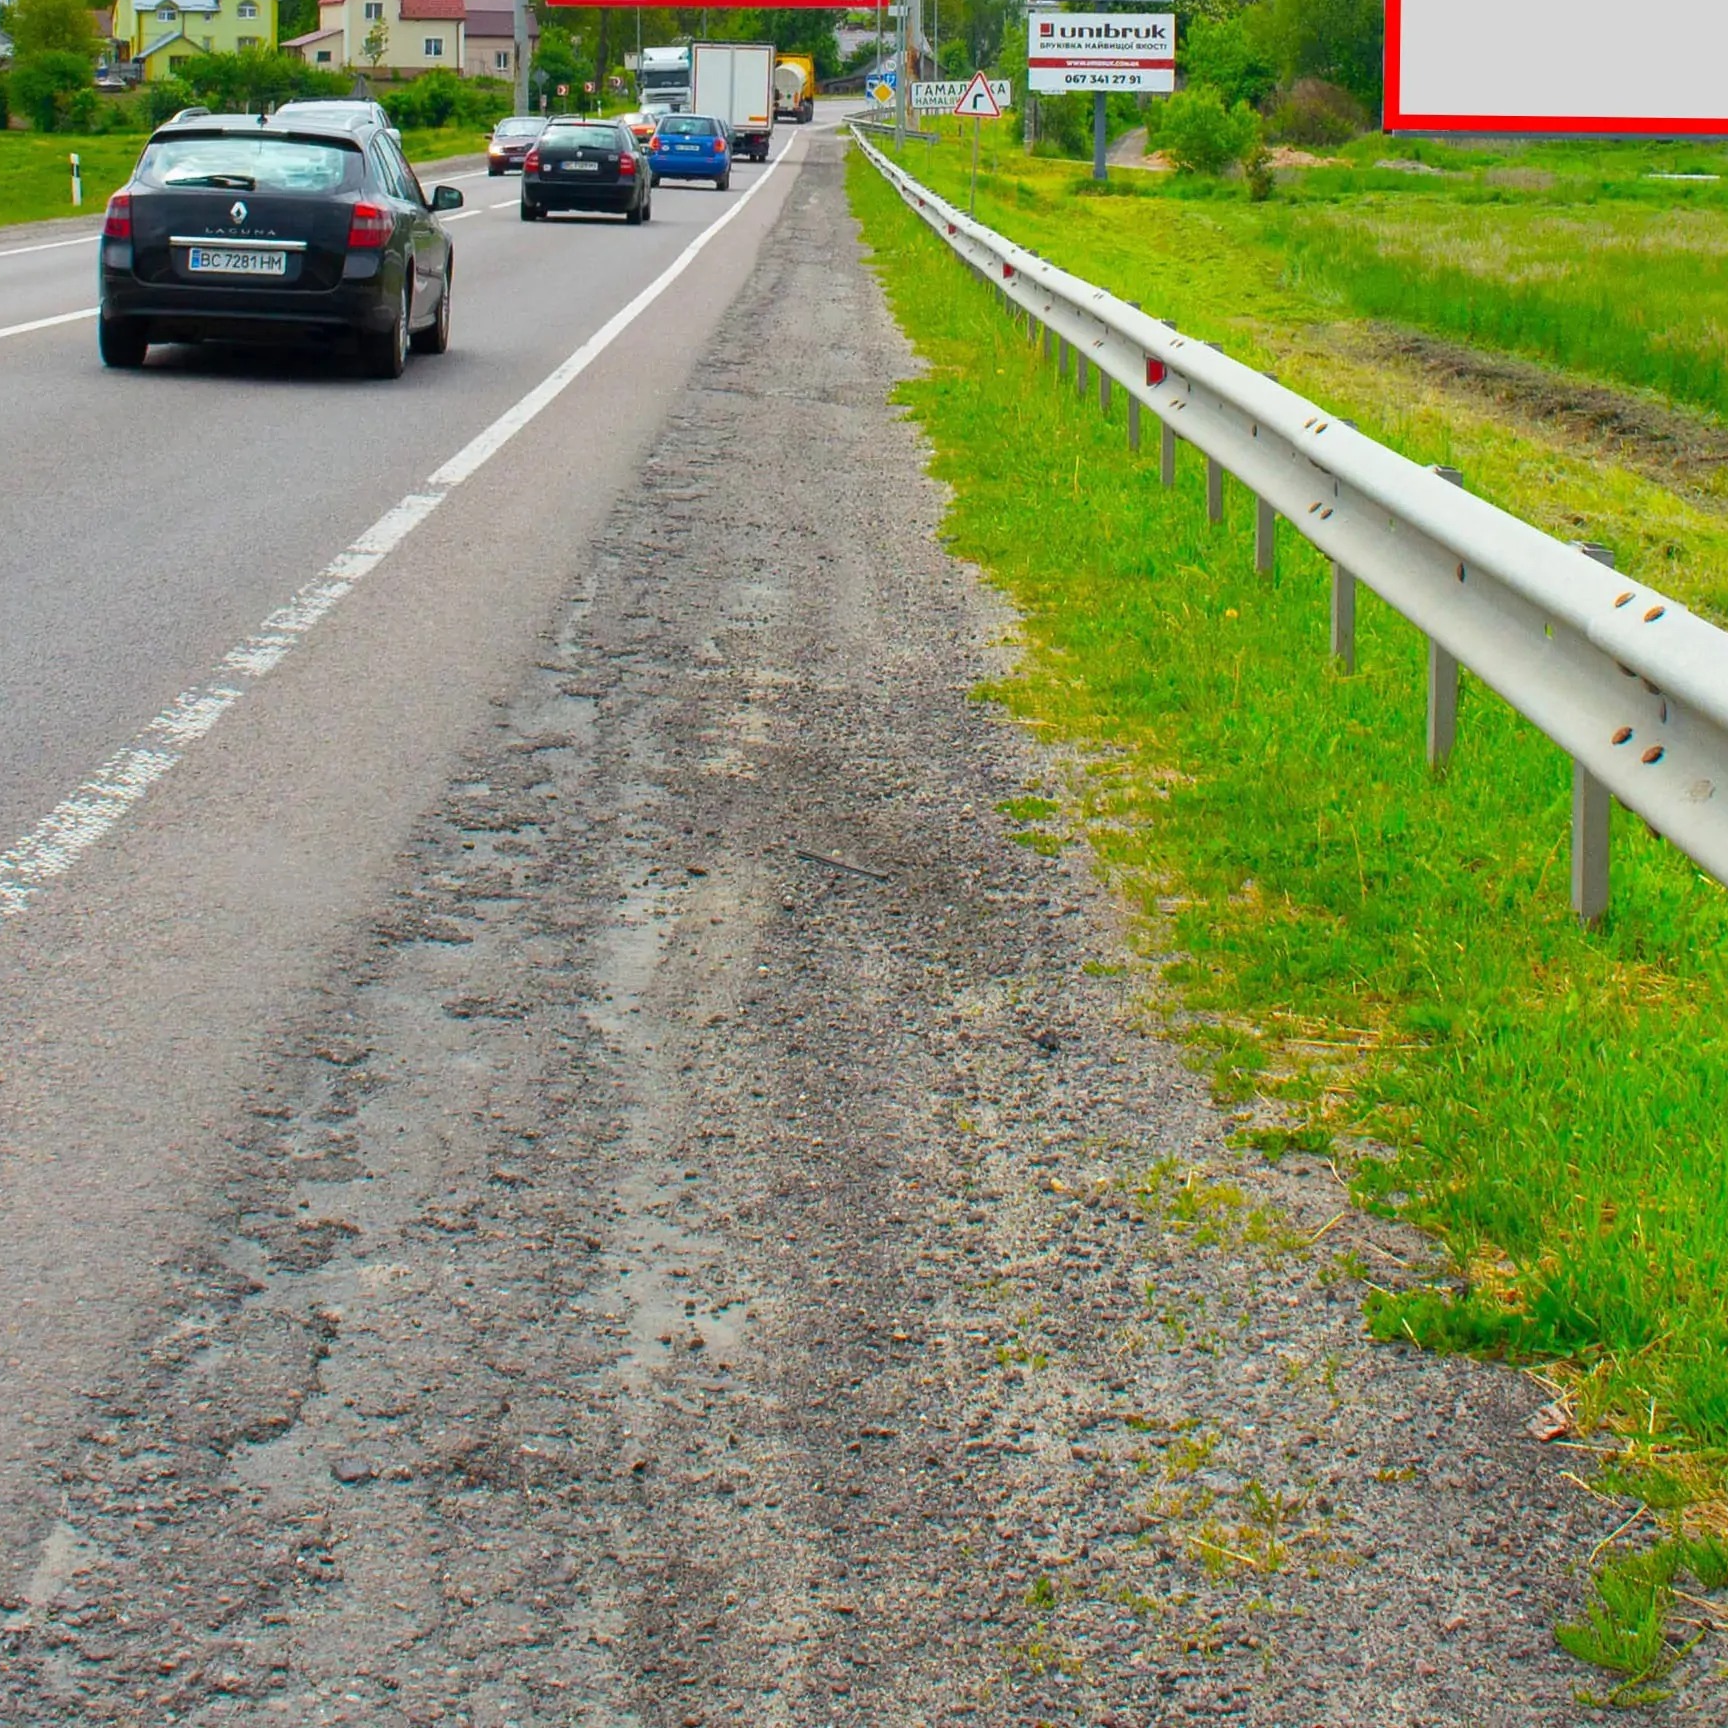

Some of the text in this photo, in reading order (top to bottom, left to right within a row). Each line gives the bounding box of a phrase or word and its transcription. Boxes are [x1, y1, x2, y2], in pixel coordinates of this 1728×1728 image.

[1060, 23, 1167, 39] unibruk
[1040, 41, 1167, 51] БРУКІВКА НАЙВИЩОЇ ЯКОСТІ
[1065, 74, 1142, 85] 067 341 27 91
[205, 227, 276, 236] LAGUNA
[200, 253, 282, 270] BC 7281 HM
